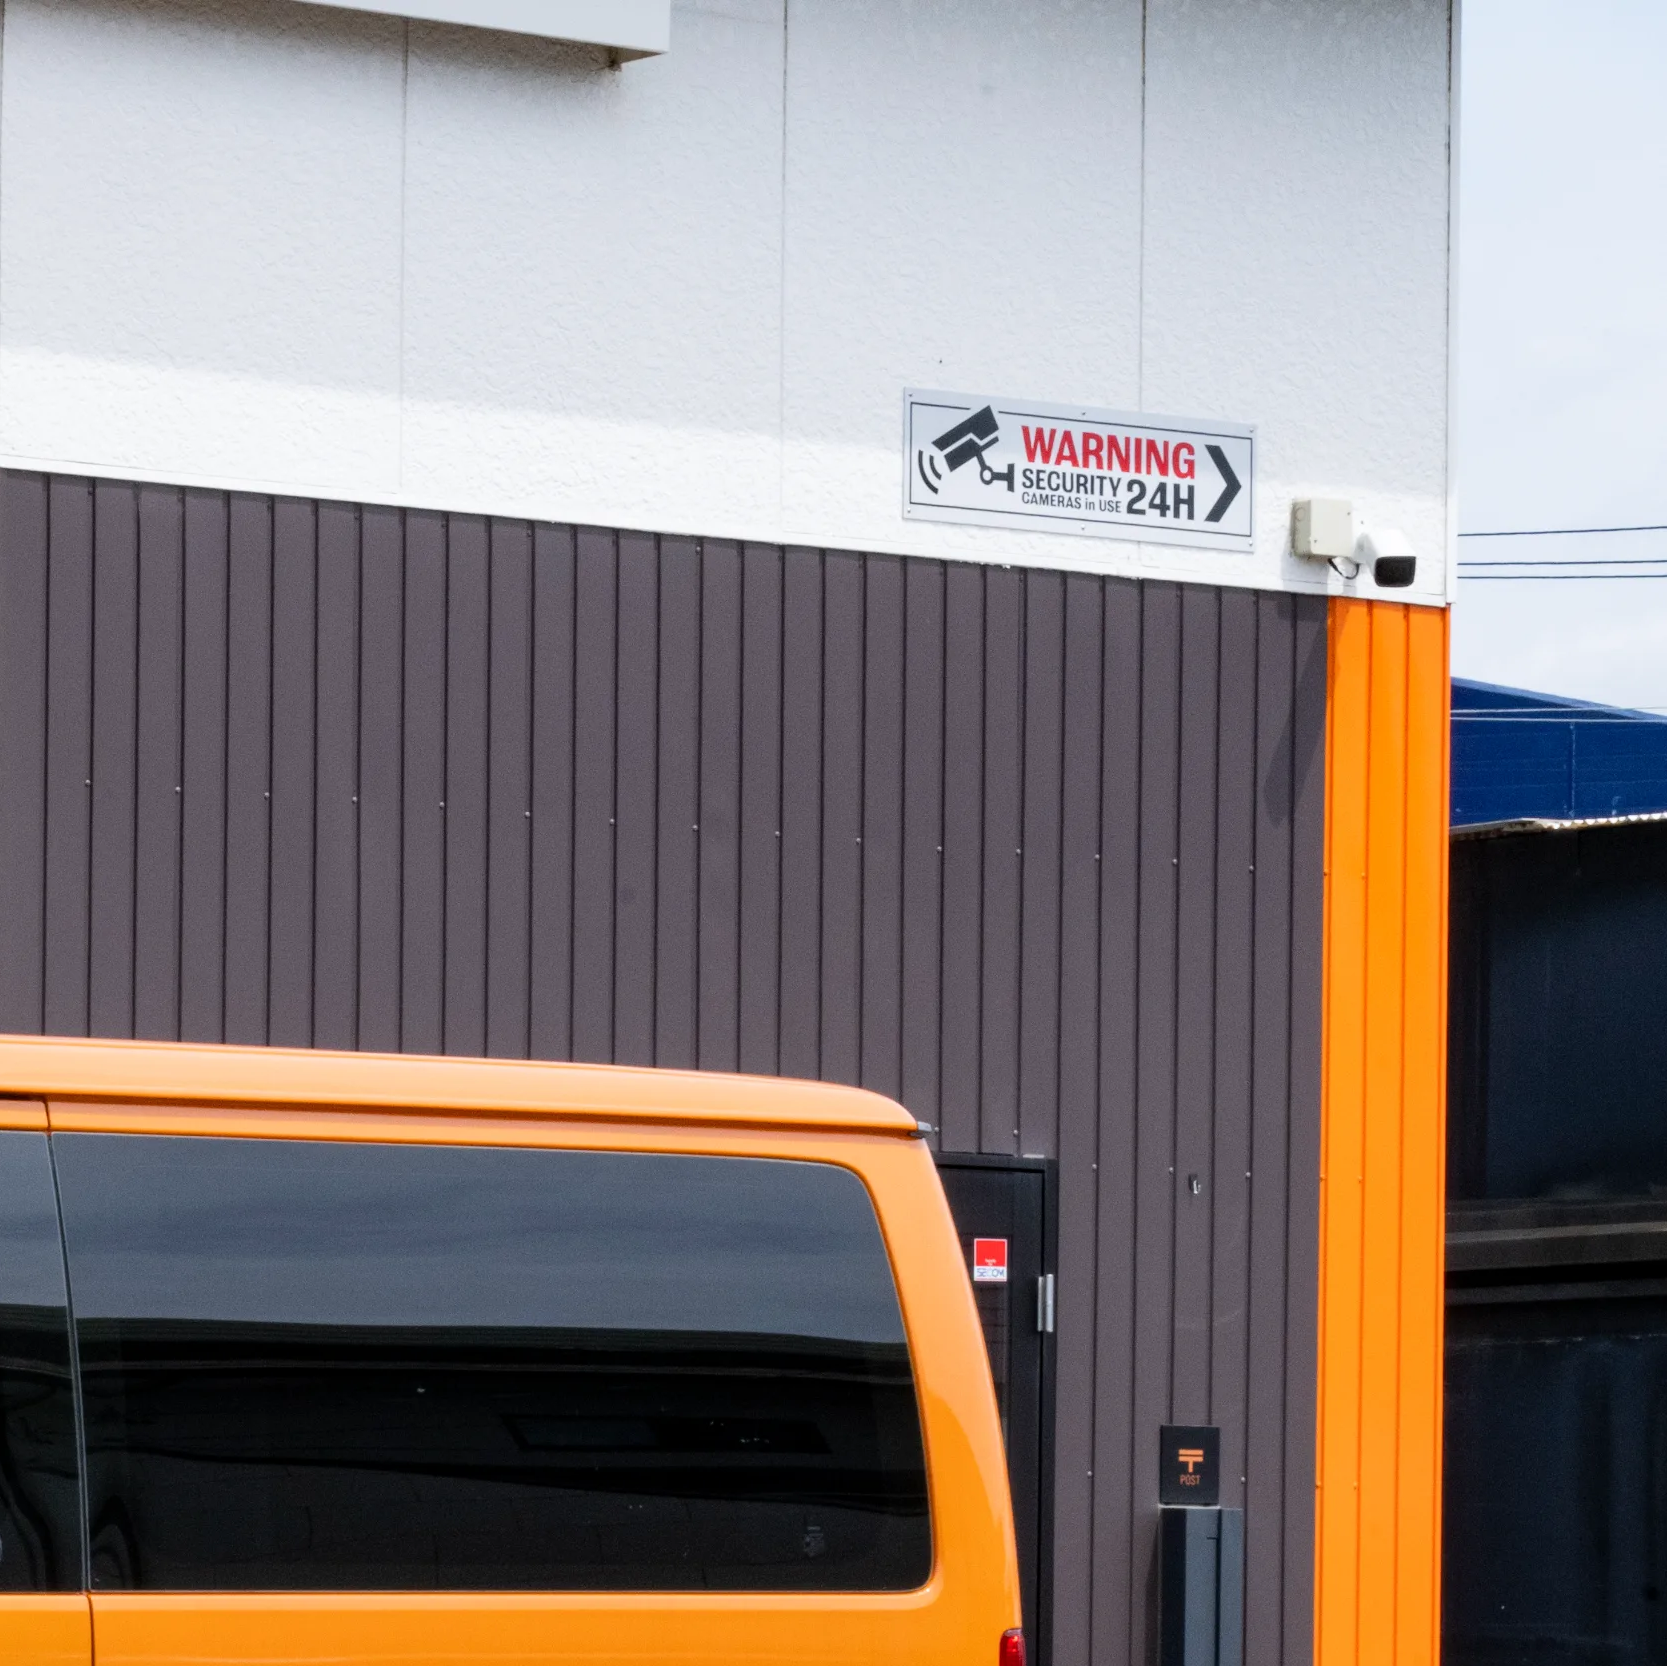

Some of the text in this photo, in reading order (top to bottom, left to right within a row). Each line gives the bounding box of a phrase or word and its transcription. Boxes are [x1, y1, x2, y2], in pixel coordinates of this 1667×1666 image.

[1021, 424, 1195, 480] WARNING
[1021, 468, 1122, 498] SECURITY
[1021, 491, 1122, 514] CAMERAS in USE
[1126, 478, 1195, 521] 24H
[1179, 1474, 1201, 1486] POST
